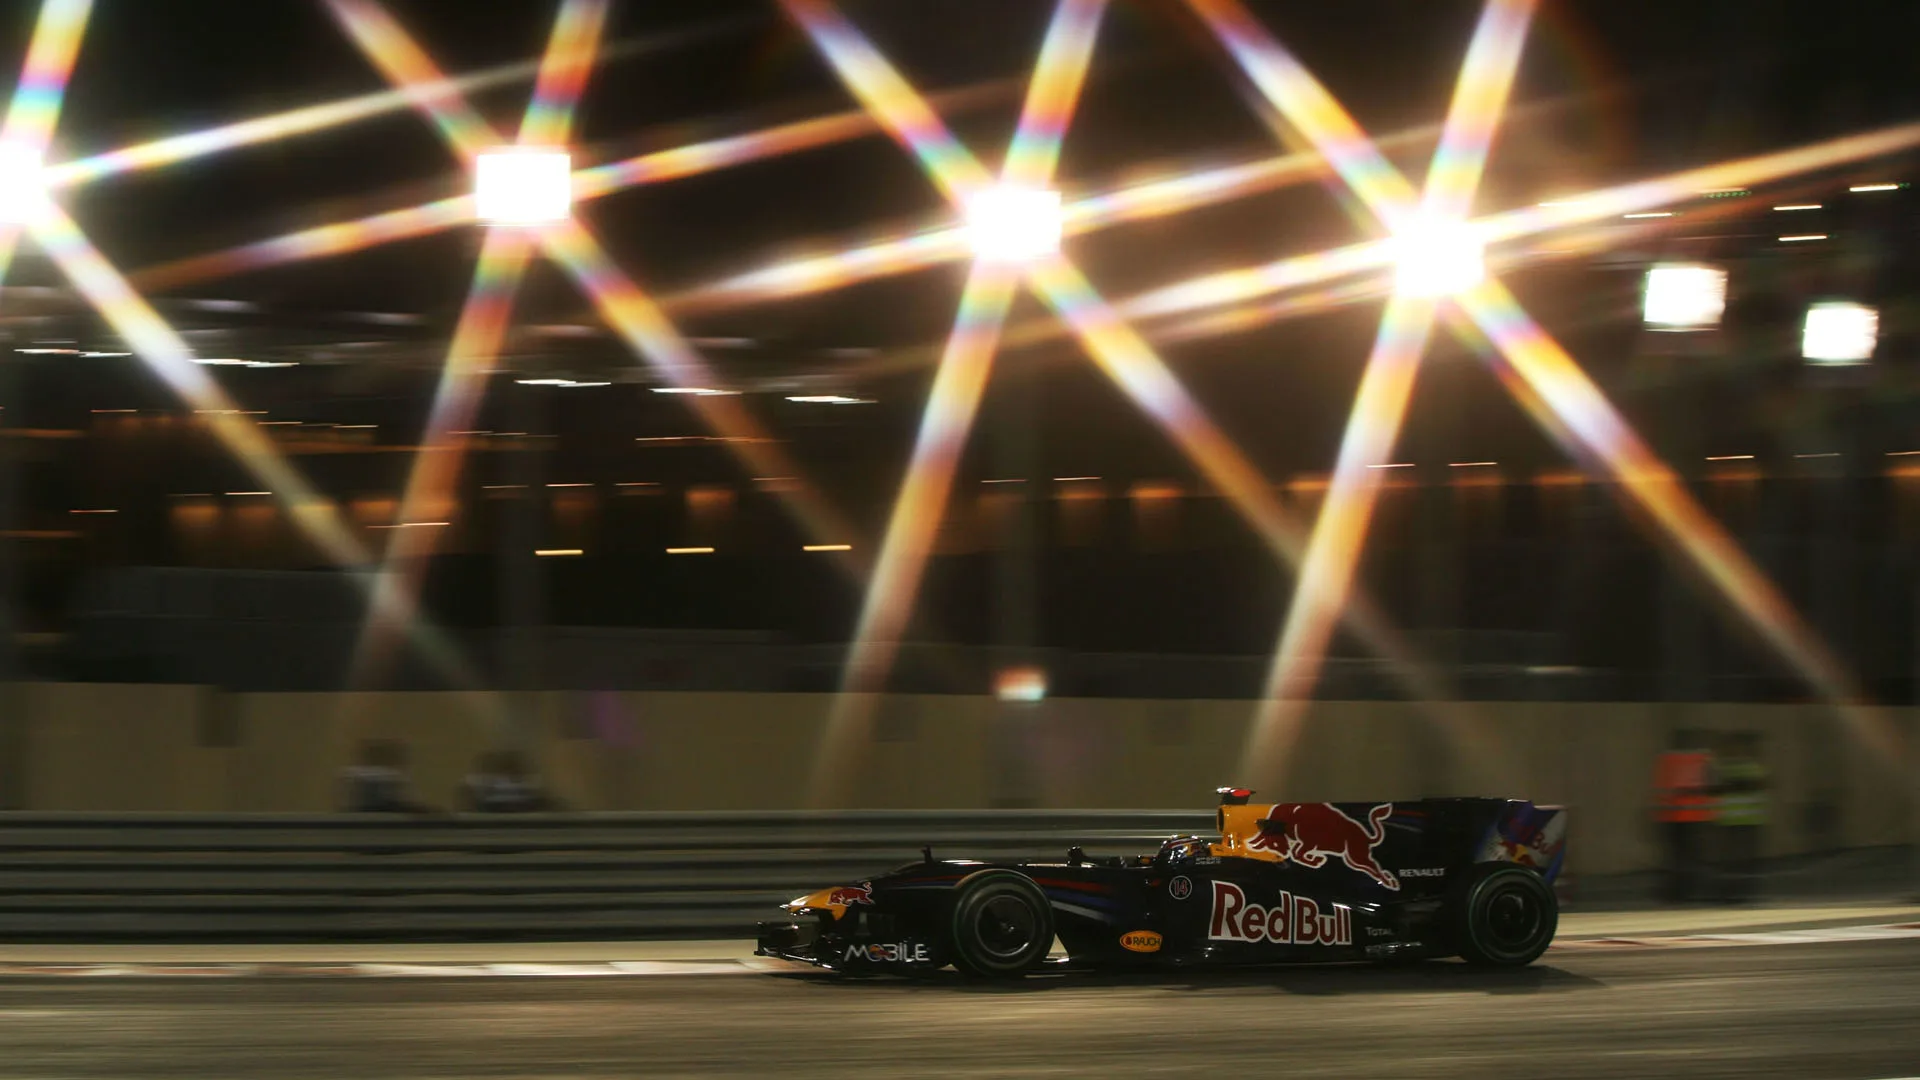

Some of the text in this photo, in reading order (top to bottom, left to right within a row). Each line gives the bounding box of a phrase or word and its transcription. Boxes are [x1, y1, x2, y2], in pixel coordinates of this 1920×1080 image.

[1399, 867, 1445, 878] RENAULT
[1174, 879, 1188, 896] 14
[1133, 936, 1161, 947] RAUCH
[843, 942, 931, 963] MOBILE
